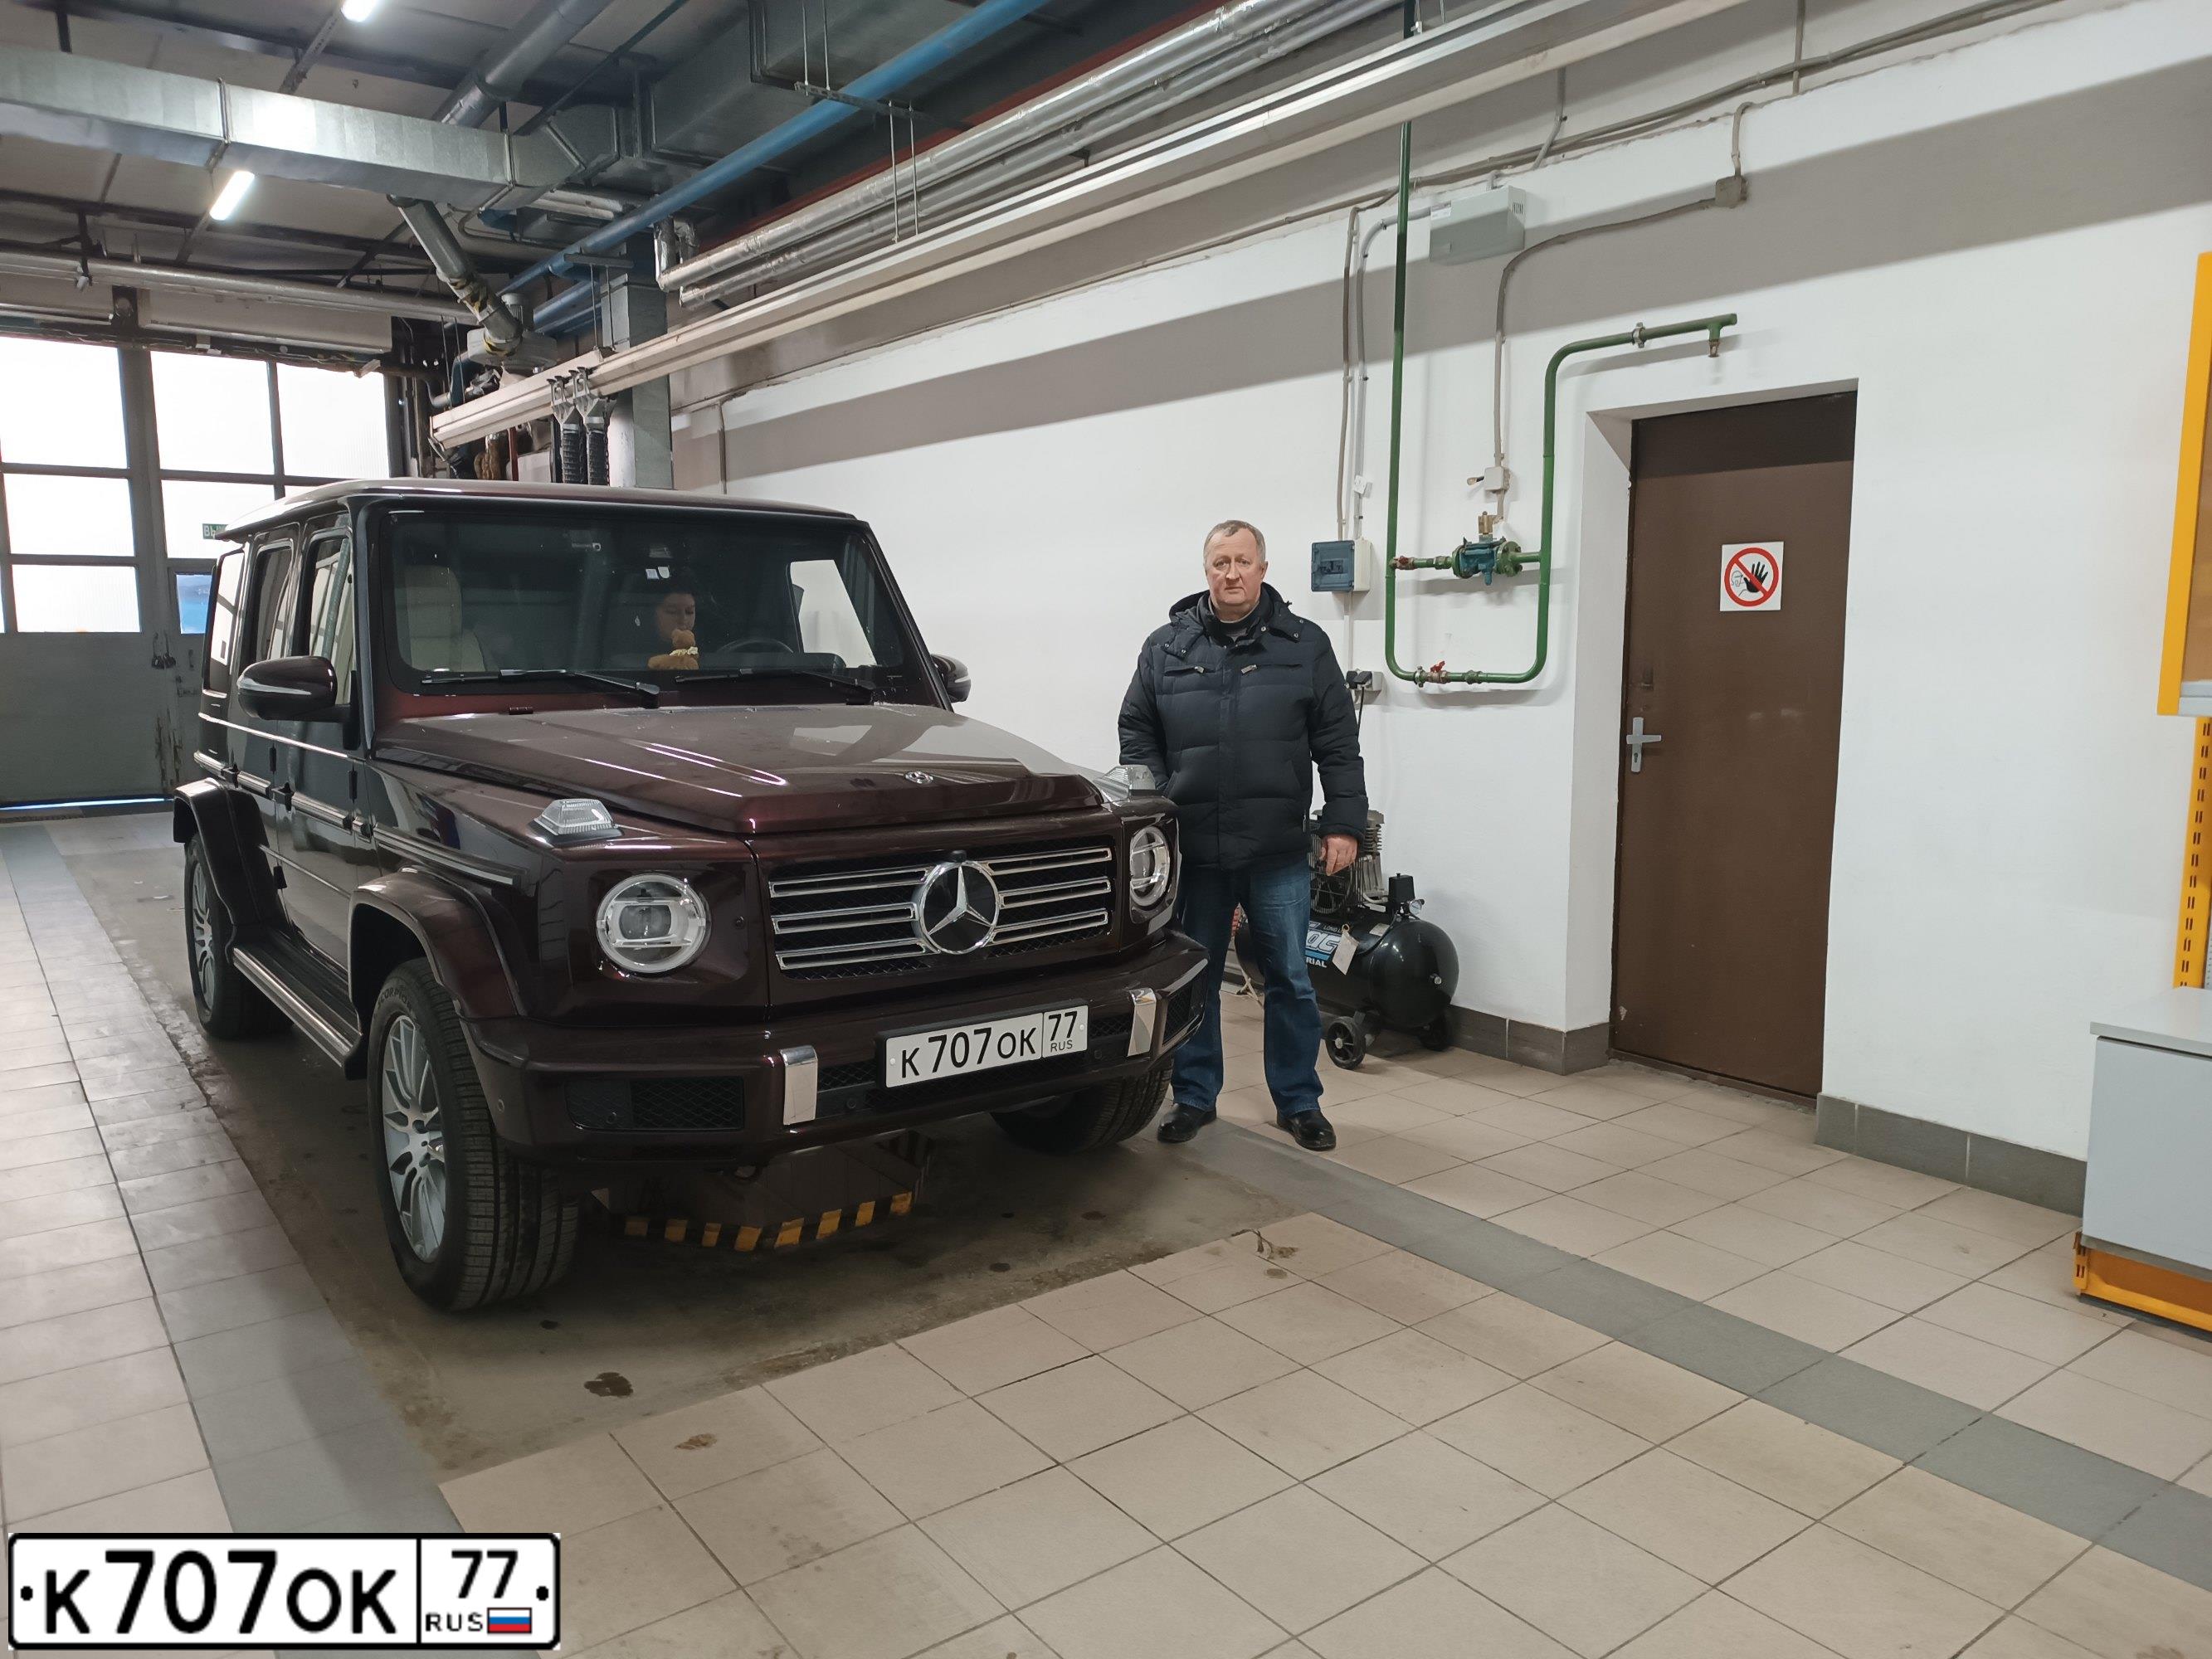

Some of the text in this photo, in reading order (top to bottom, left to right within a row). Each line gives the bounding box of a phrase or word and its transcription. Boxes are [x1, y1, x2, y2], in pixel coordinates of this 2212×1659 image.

[1306, 956, 1328, 969] RIAL
[901, 1010, 1078, 1078] К707ОК 77
[1050, 1039, 1074, 1053] RUS
